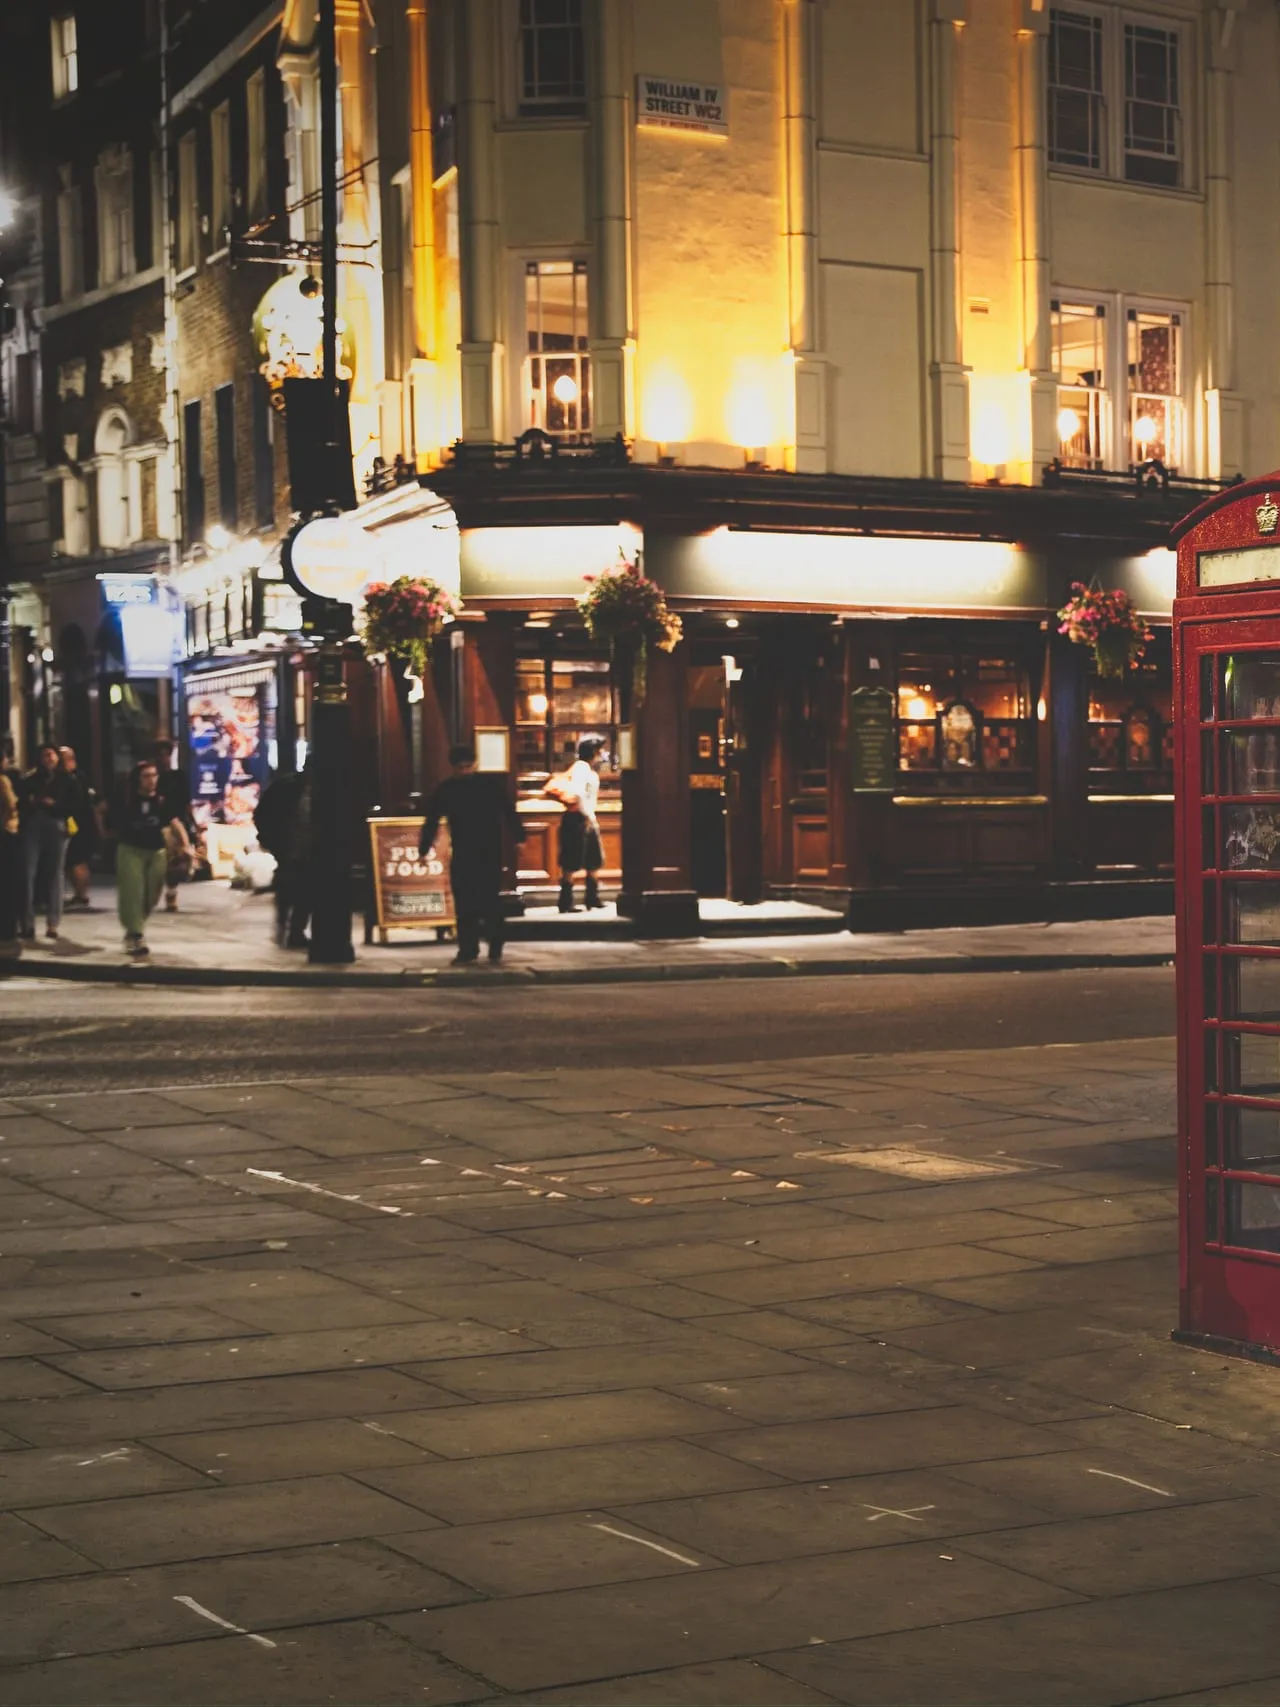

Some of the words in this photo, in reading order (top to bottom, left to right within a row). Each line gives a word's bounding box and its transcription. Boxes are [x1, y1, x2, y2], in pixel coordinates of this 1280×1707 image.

[645, 81, 700, 101] WILLIAM
[704, 88, 718, 104] IV
[645, 97, 690, 116] STREET
[694, 103, 722, 120] WC2
